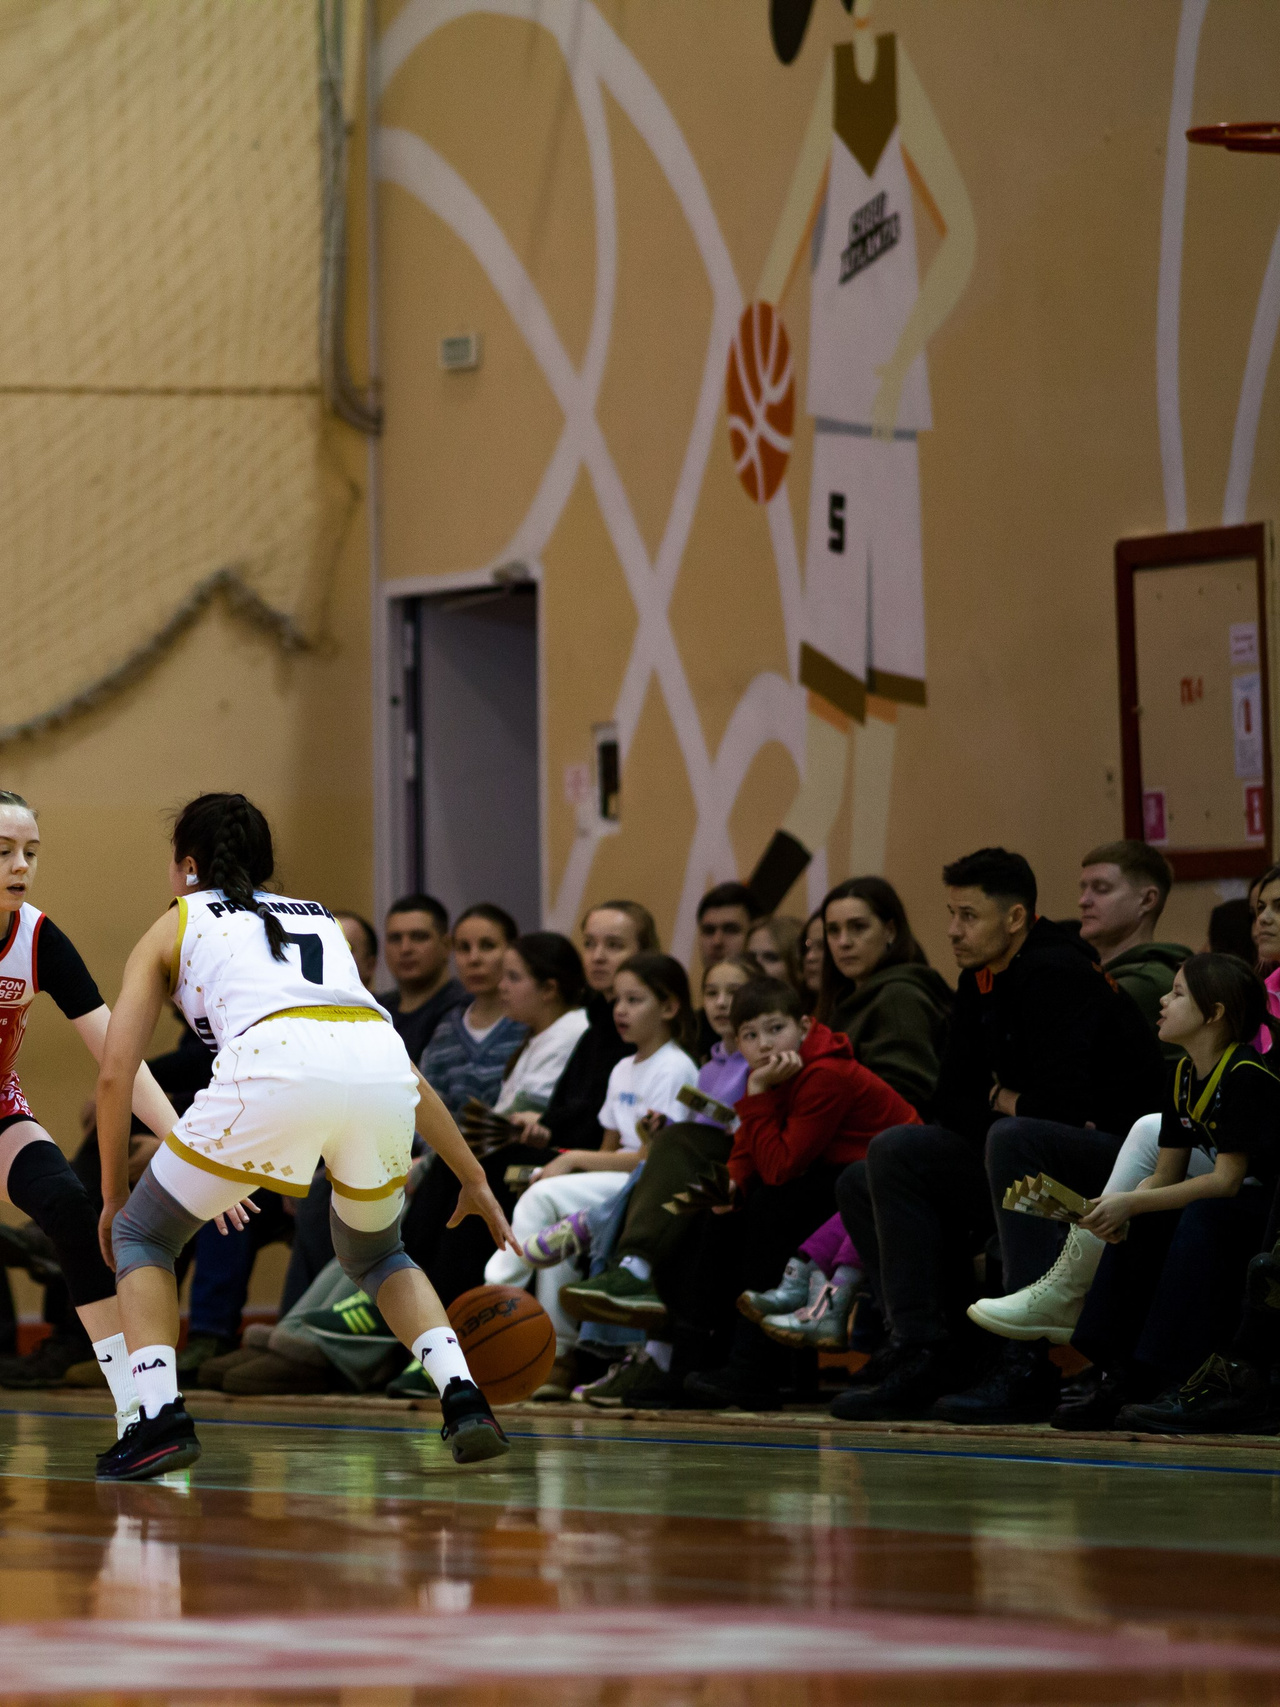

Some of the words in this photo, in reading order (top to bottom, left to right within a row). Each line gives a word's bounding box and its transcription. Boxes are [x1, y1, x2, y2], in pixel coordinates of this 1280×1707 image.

[206, 899, 336, 924] РАМОВА
[280, 931, 324, 985] 7
[132, 1358, 167, 1378] FILA
